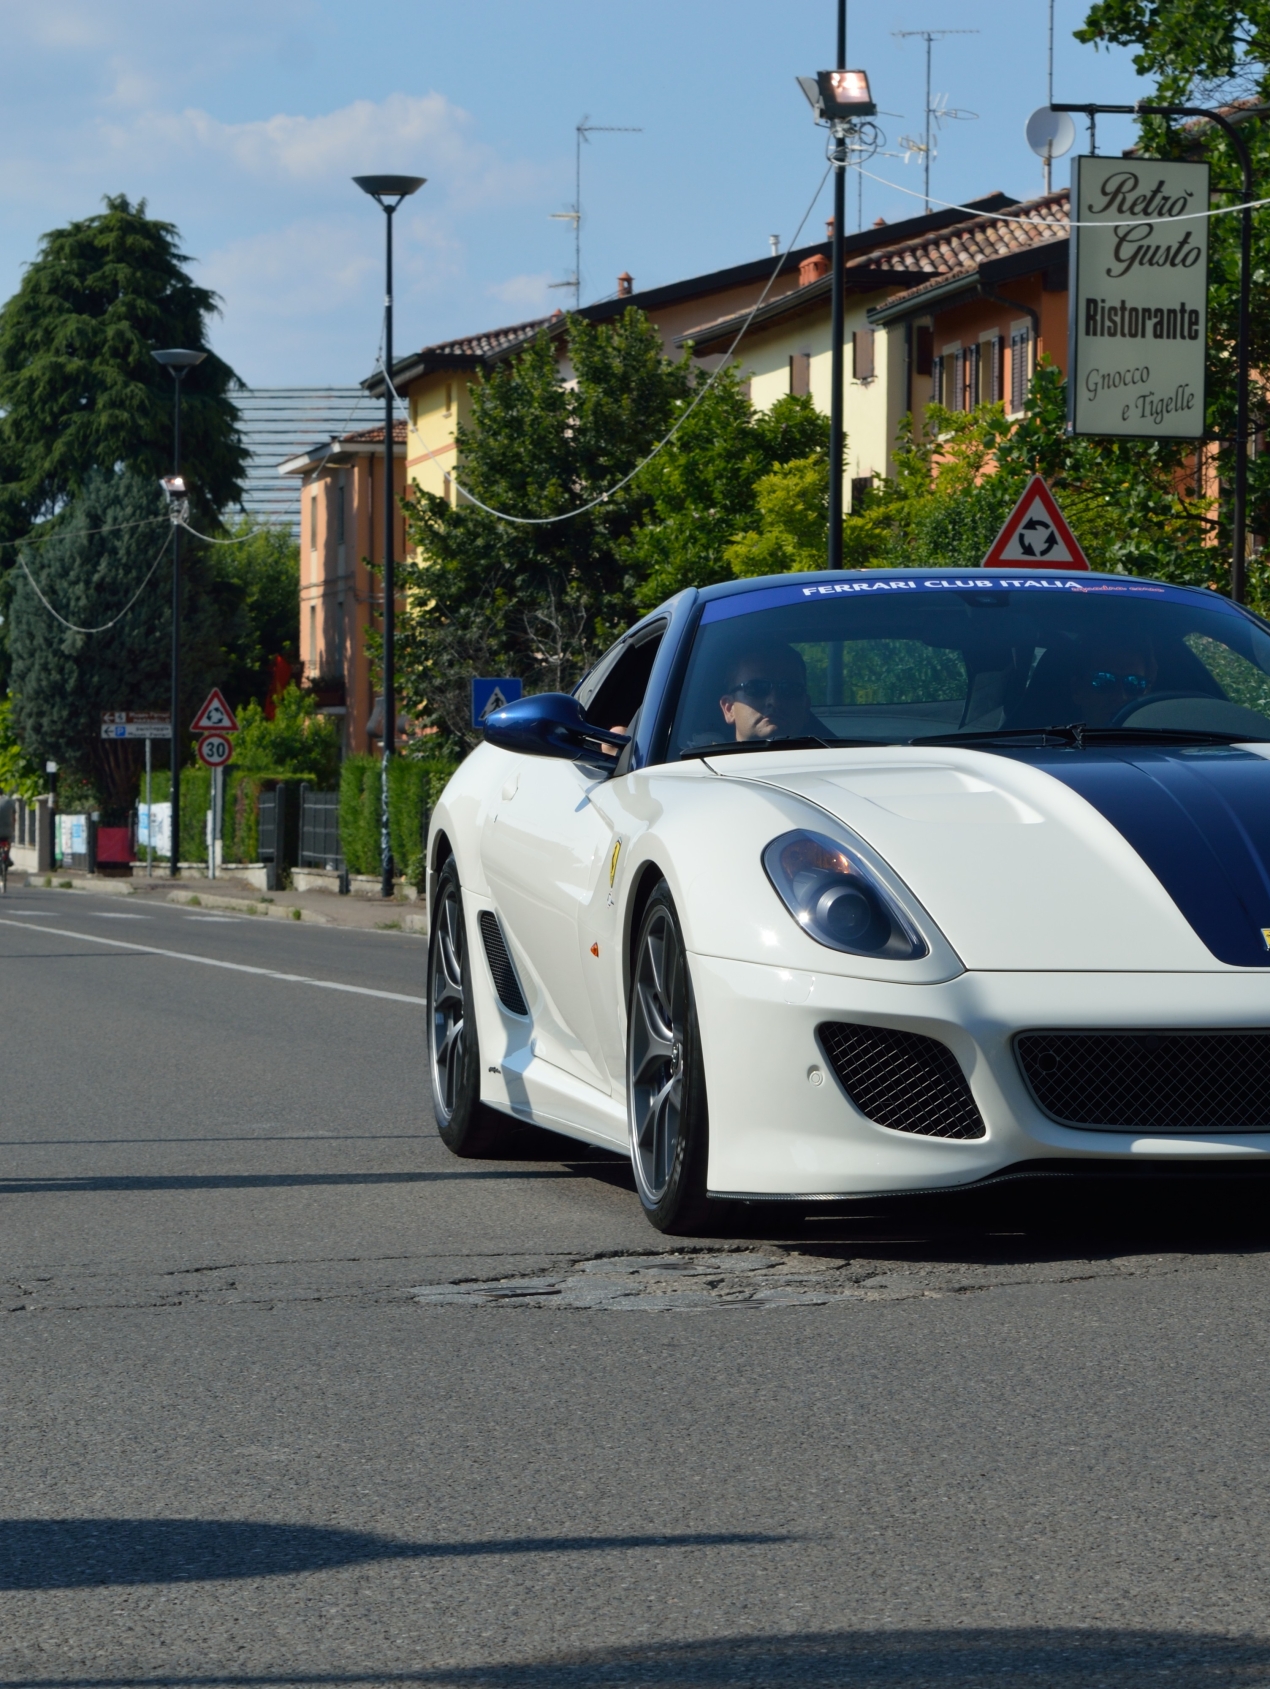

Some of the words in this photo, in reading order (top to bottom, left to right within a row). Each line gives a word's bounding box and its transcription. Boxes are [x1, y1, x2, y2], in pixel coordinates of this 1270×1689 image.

[1088, 171, 1194, 218] Retrò
[1106, 223, 1202, 278] Gusto
[1085, 298, 1200, 340] Ristorante
[1086, 366, 1150, 402] Gnocco
[1122, 403, 1130, 421] e
[1136, 384, 1195, 425] Tigelle
[802, 580, 917, 596] FERRARI
[924, 580, 993, 588] CLUB
[999, 580, 1084, 588] ITALIA
[206, 741, 226, 758] 30
